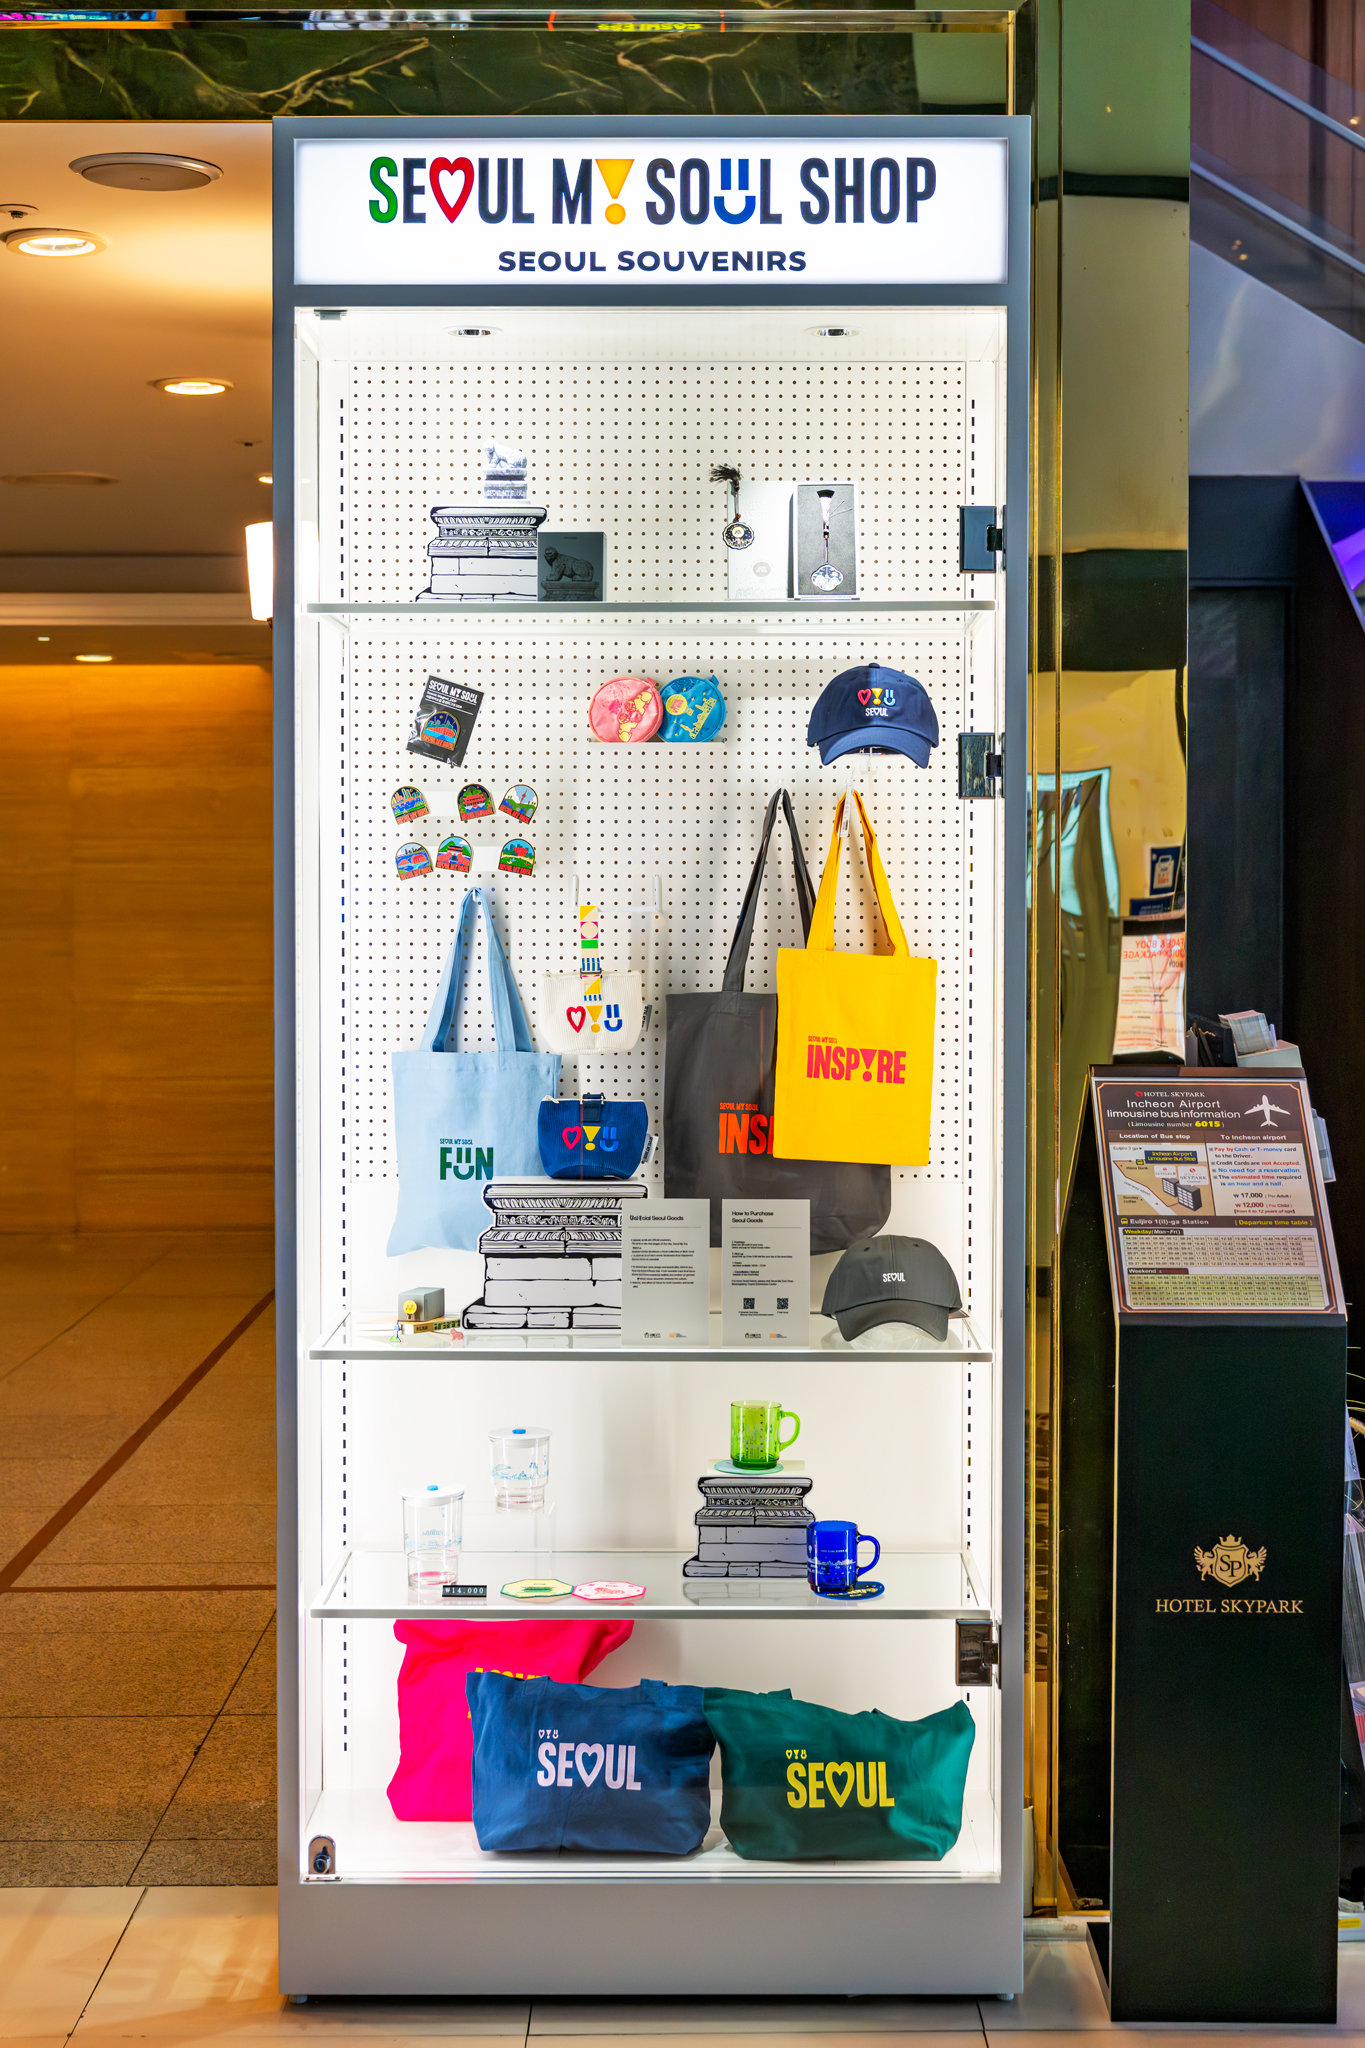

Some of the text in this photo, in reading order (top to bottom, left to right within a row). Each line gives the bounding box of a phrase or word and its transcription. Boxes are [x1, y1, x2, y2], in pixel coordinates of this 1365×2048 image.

[800, 157, 937, 225] SHOP
[498, 250, 807, 273] SEOUL SOUVENIRS
[1180, 1100, 1220, 1109] Airport
[1107, 1110, 1240, 1118] limousine bus information
[1155, 1599, 1304, 1614] HOTEL SKYPARK
